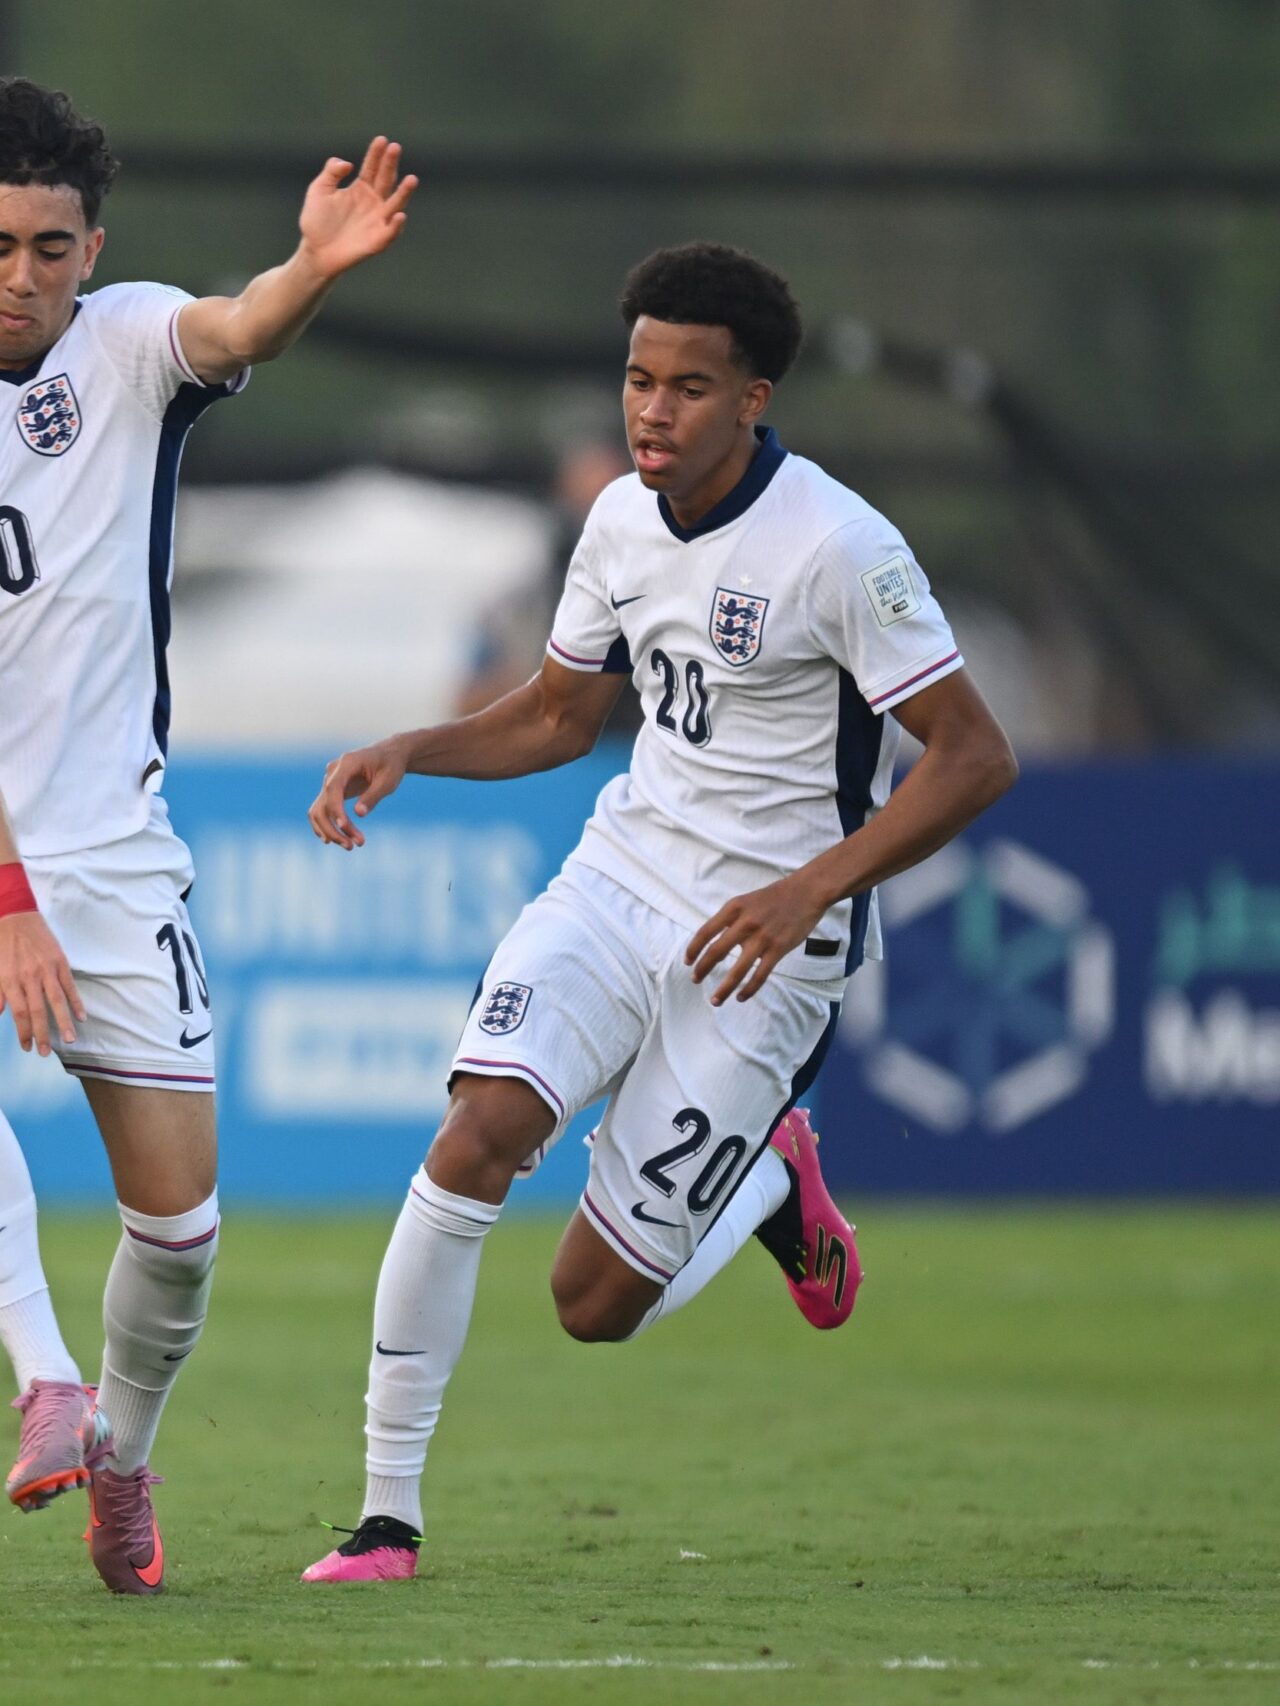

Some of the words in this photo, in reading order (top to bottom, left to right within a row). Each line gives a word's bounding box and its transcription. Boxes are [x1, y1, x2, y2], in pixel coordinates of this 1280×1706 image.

[872, 566, 901, 585] FOOTBALL
[876, 574, 904, 597] UNITES
[651, 648, 712, 748] 20
[640, 1107, 746, 1216] 20
